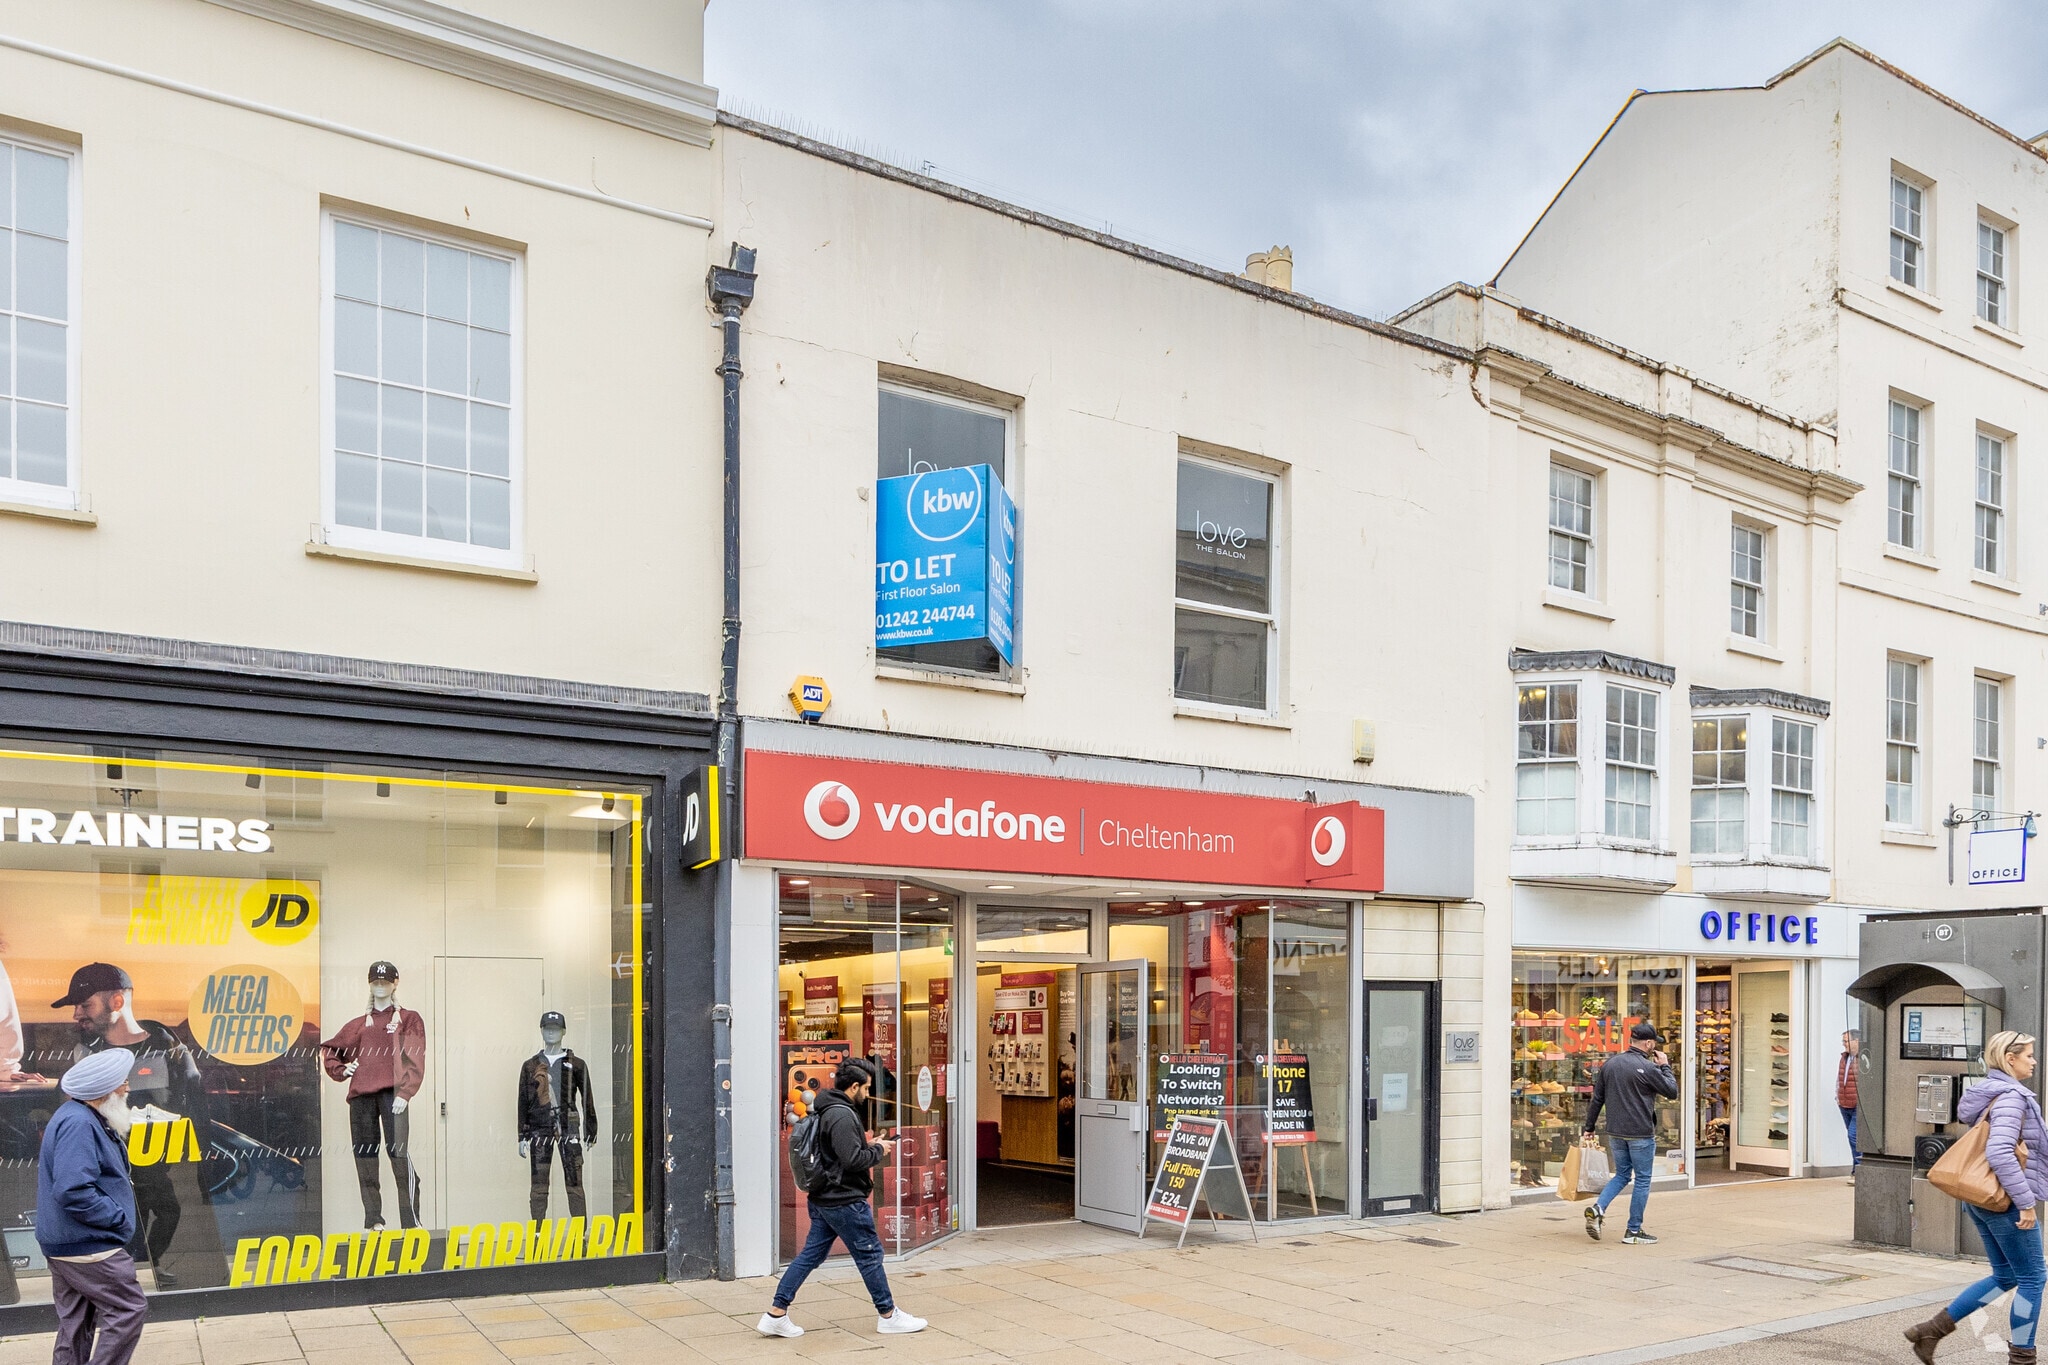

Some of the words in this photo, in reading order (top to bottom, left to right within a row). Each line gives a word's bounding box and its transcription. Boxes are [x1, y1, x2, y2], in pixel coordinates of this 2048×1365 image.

[923, 488, 975, 515] kbw
[1196, 510, 1247, 549] love
[1196, 543, 1213, 553] THE
[1216, 548, 1246, 560] SALON
[877, 559, 909, 585] TO
[915, 554, 956, 581] LET
[991, 554, 1000, 584] TO
[1001, 571, 1012, 599] LET
[876, 587, 898, 602] First
[900, 585, 927, 599] Floor
[930, 582, 961, 596] Salon
[877, 608, 918, 629] 01242
[922, 604, 975, 624] 244744
[877, 628, 934, 641] www.kbw.co.uk
[804, 688, 822, 700] ADT
[683, 792, 700, 846] JD
[874, 797, 1066, 843] vodafone
[1099, 819, 1234, 854] Cheltenham
[1972, 868, 2018, 879] OFFICE
[251, 893, 310, 929] JD
[126, 908, 235, 945] FORWARD
[1700, 911, 1818, 944] OFFICE
[1938, 928, 1949, 937] BT
[202, 975, 268, 1014] MEGA
[206, 1014, 293, 1055] OFFERS
[1453, 1034, 1475, 1049] love
[787, 1051, 843, 1064] PRO
[1170, 1064, 1220, 1077] Looking
[1161, 1079, 1177, 1089] To
[1180, 1079, 1222, 1090] Switch
[1277, 1080, 1292, 1093] 17
[1157, 1094, 1225, 1105] Networks?
[1275, 1099, 1296, 1107] SAVE
[1290, 1110, 1307, 1118] YOU
[1296, 1121, 1304, 1129] IN
[1175, 1132, 1196, 1145] SAVE
[1197, 1136, 1211, 1147] ON
[1167, 1146, 1208, 1161] BROADBAND
[1163, 1160, 1180, 1174] Full
[1180, 1164, 1200, 1178] Fibre
[1169, 1175, 1185, 1189] 150
[1160, 1191, 1181, 1208] £24
[230, 1228, 430, 1288] FOREVER
[443, 1212, 641, 1271] FORWARD
